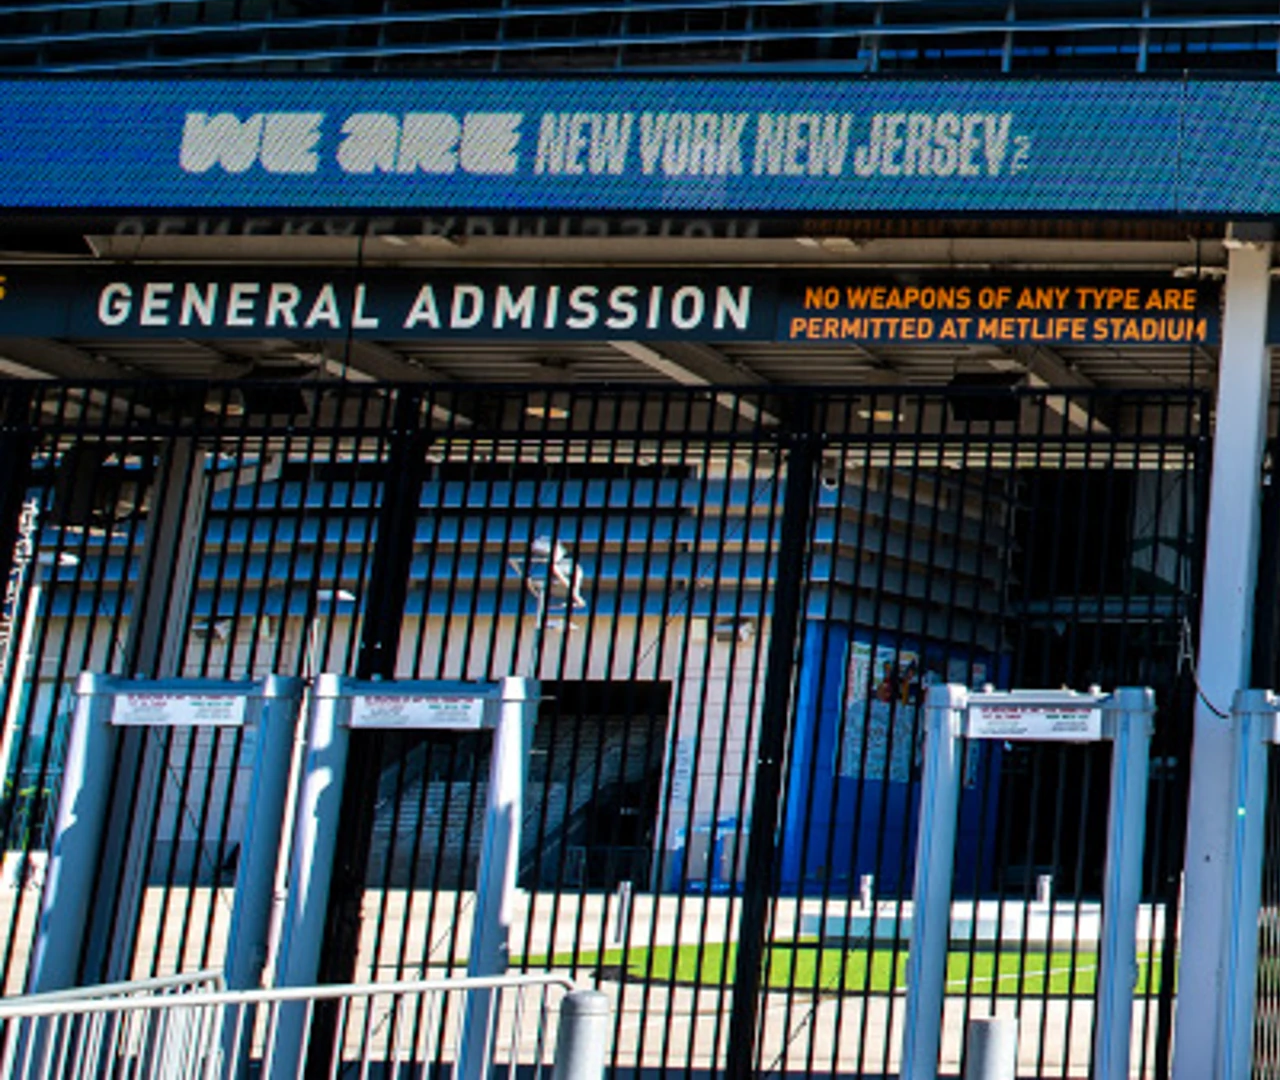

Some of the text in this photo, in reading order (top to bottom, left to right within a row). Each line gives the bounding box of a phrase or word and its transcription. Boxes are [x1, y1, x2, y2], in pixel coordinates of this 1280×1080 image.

[180, 112, 325, 174] WE
[337, 112, 524, 174] ARE
[534, 113, 632, 176] NEW
[638, 113, 749, 176] YORK
[753, 113, 853, 176] NEW
[854, 113, 1012, 177] JERSEY
[97, 281, 752, 332] GENERAL ADMISSION
[804, 286, 1197, 312] NO WEAPONS OF ANY TYPE ARE
[789, 317, 1208, 342] PERMITTED AT METLIFE STADIUM
